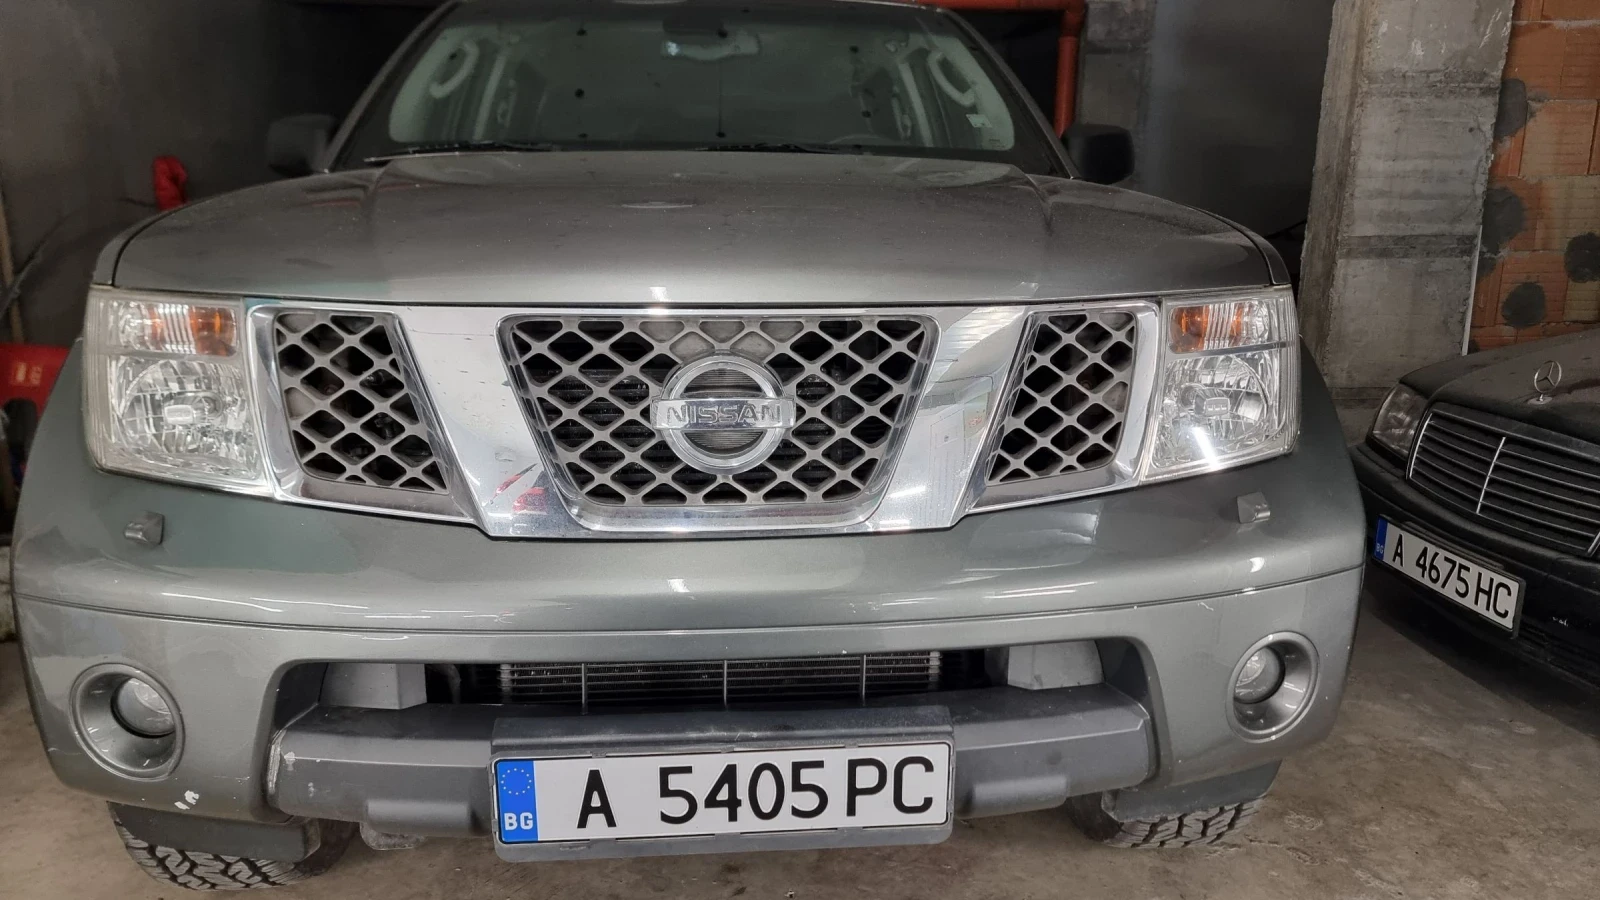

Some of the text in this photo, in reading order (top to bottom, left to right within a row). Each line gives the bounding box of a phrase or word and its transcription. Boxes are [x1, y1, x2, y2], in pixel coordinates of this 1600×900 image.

[666, 404, 781, 424] NISSAN
[1392, 533, 1512, 620] A 4675 HC
[576, 755, 935, 829] A 5405 PC
[504, 812, 534, 831] BG
